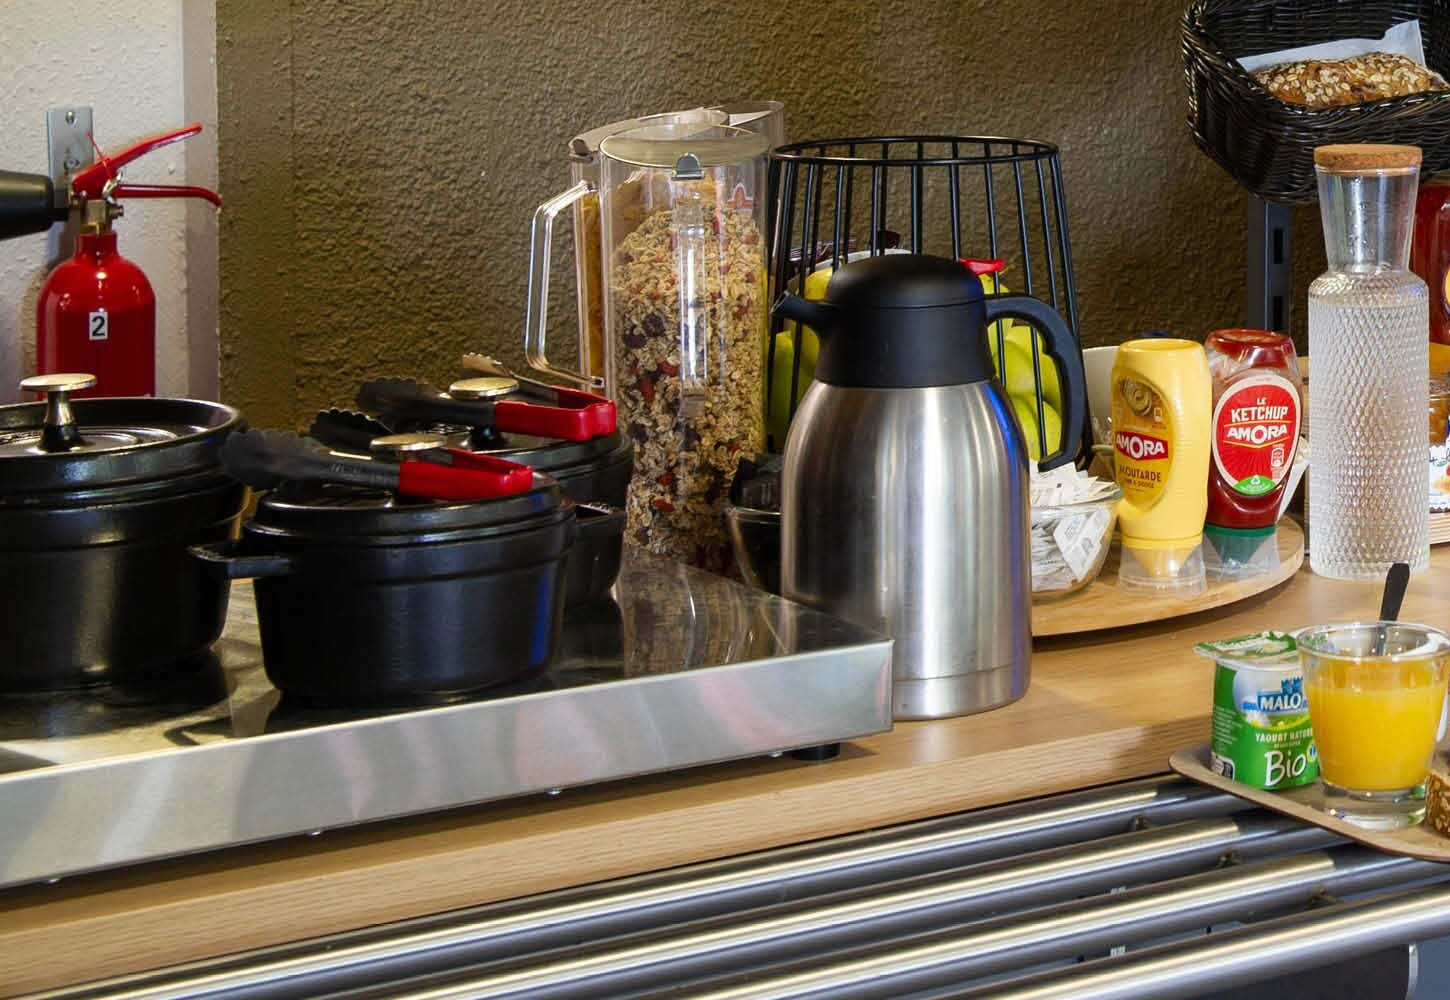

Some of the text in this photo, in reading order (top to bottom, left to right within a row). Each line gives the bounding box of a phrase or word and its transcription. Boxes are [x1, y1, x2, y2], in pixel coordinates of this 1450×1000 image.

[91, 315, 106, 337] 2
[1231, 405, 1289, 423] KETCHUP
[1226, 424, 1288, 444] AMORA
[1116, 431, 1165, 459] AMORA
[1260, 693, 1302, 711] MALO
[1255, 731, 1288, 743] YAOURT
[1264, 749, 1307, 786] Bio
